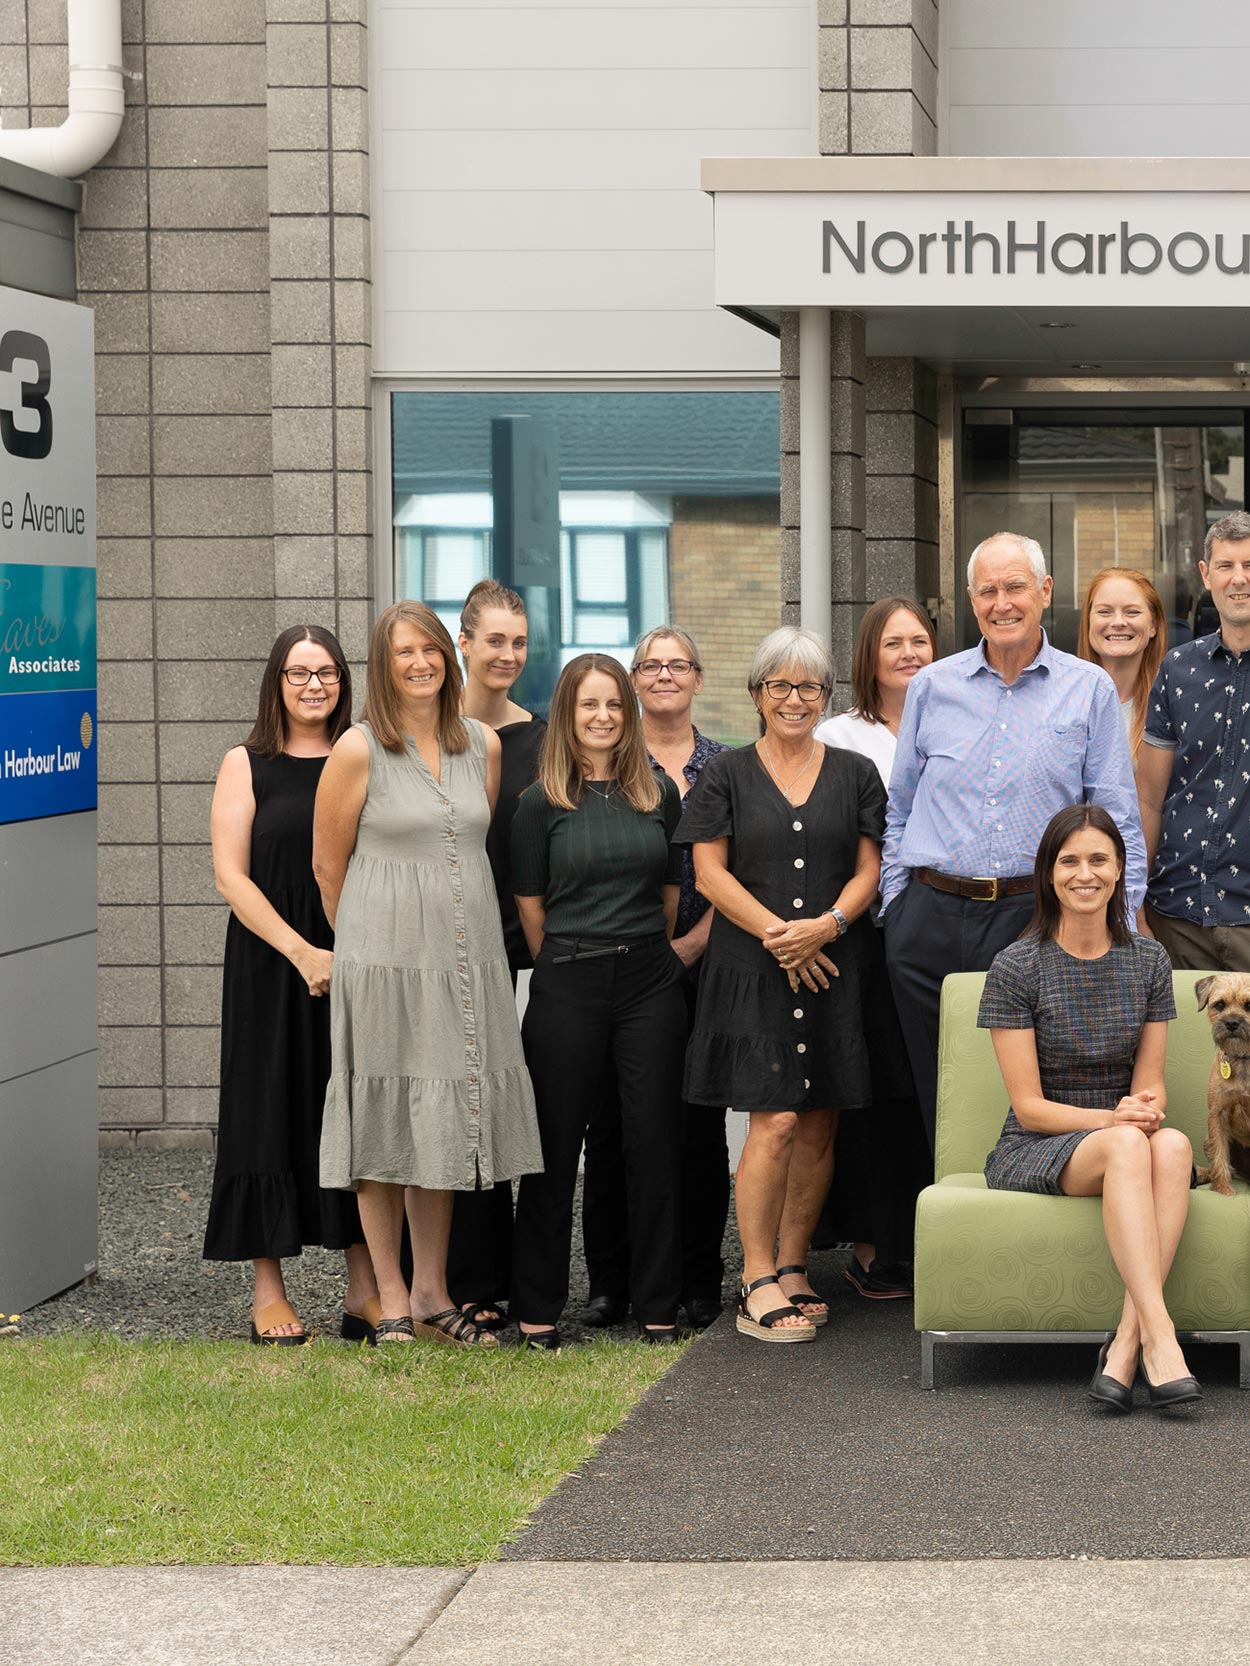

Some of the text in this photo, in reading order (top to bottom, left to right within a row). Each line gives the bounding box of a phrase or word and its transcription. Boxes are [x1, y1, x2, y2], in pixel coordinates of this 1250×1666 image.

[0, 330, 53, 460] 3
[21, 492, 85, 535] Avenue
[0, 608, 66, 654] aves
[8, 656, 81, 674] Associates
[5, 744, 81, 778] Harbour Law
